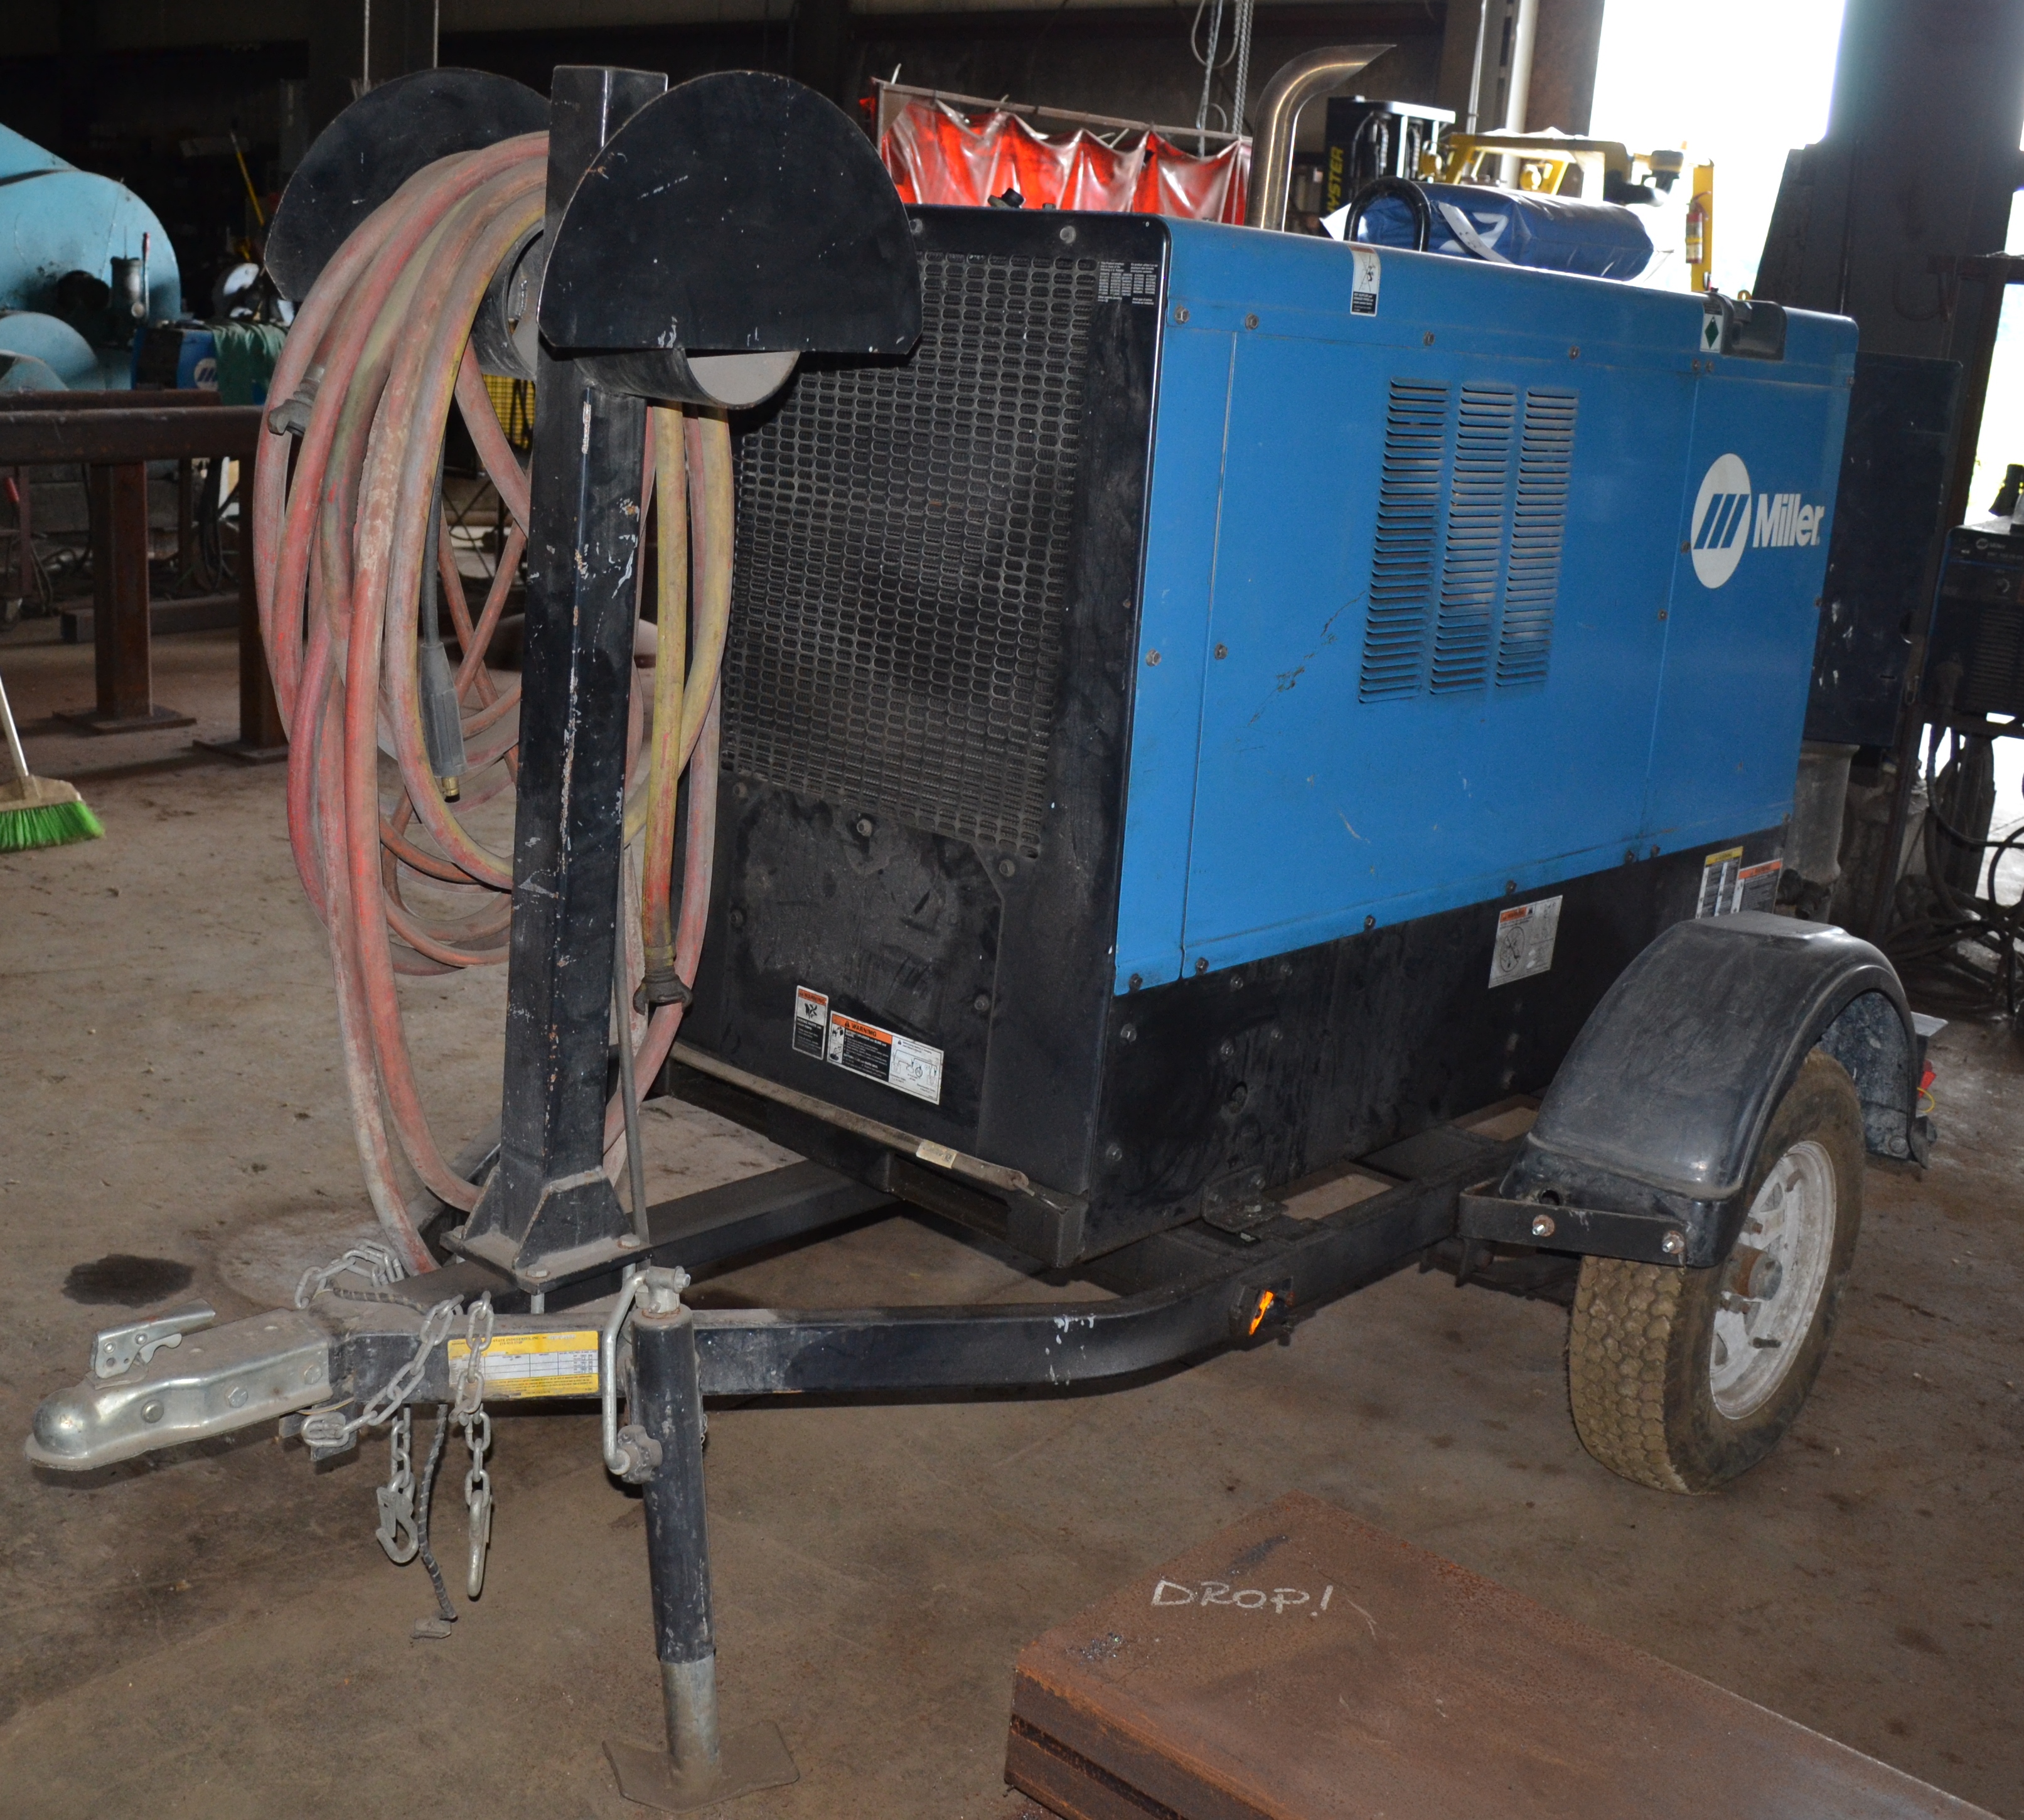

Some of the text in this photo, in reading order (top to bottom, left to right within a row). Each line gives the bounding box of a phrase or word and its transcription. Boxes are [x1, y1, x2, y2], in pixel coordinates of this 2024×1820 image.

[1752, 493, 1825, 548] Miller
[851, 1022, 877, 1037] WARNING
[1151, 1579, 1334, 1617] DROP!
